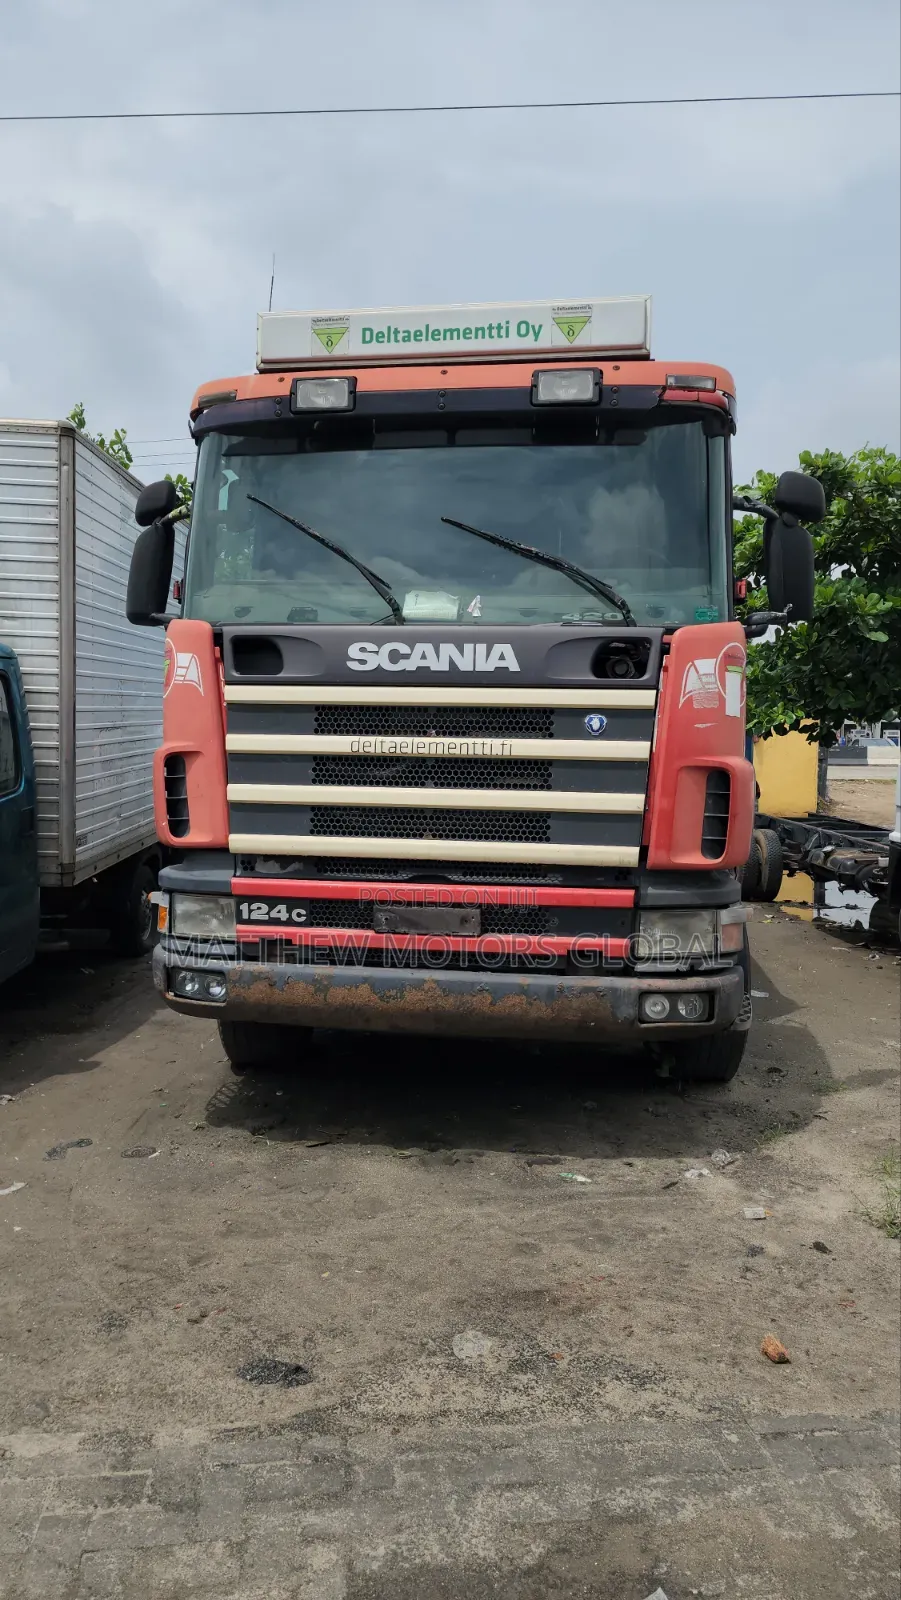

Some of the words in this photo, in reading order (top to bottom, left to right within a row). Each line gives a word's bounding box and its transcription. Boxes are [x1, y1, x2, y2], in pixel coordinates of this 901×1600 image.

[361, 320, 510, 344] Deltaelementti
[516, 320, 543, 342] Oy
[346, 641, 521, 672] SCANIA
[350, 737, 513, 756] deltaelementti.fi
